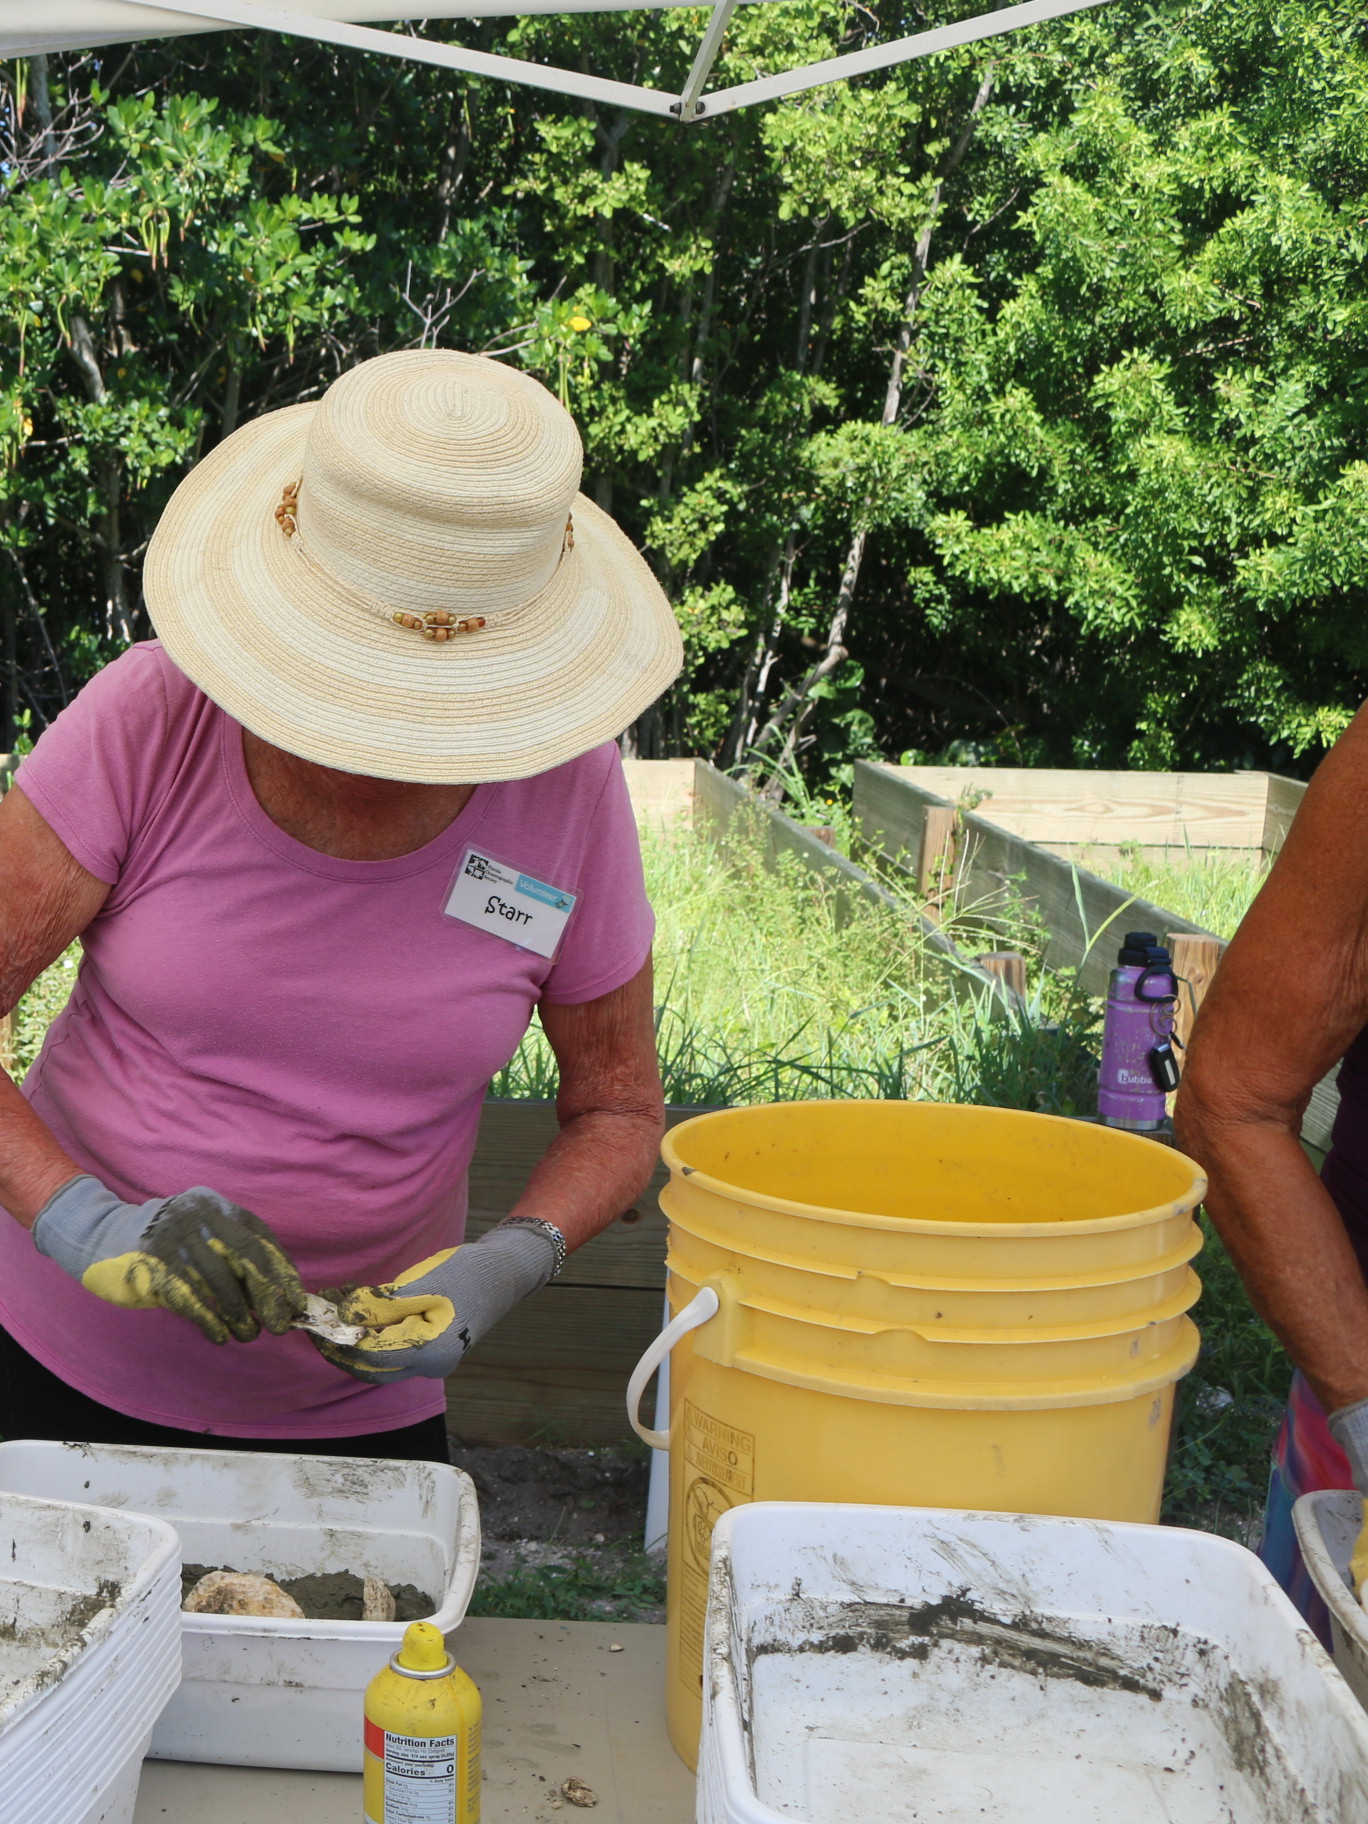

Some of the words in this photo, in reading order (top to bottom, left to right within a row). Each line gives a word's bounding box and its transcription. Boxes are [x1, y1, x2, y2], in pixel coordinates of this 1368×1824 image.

[487, 865, 502, 874] Florida
[484, 875, 498, 884] Society
[520, 879, 558, 901] Volunteer
[484, 895, 533, 925] Starr
[1117, 1069, 1152, 1084] bubba
[694, 1412, 751, 1452] WARNING
[702, 1437, 738, 1466] AVISO
[386, 1733, 426, 1747] Nutrition
[430, 1739, 454, 1747] Facts
[386, 1757, 403, 1765] Amount
[386, 1762, 425, 1775] Calories
[447, 1764, 454, 1774] 0
